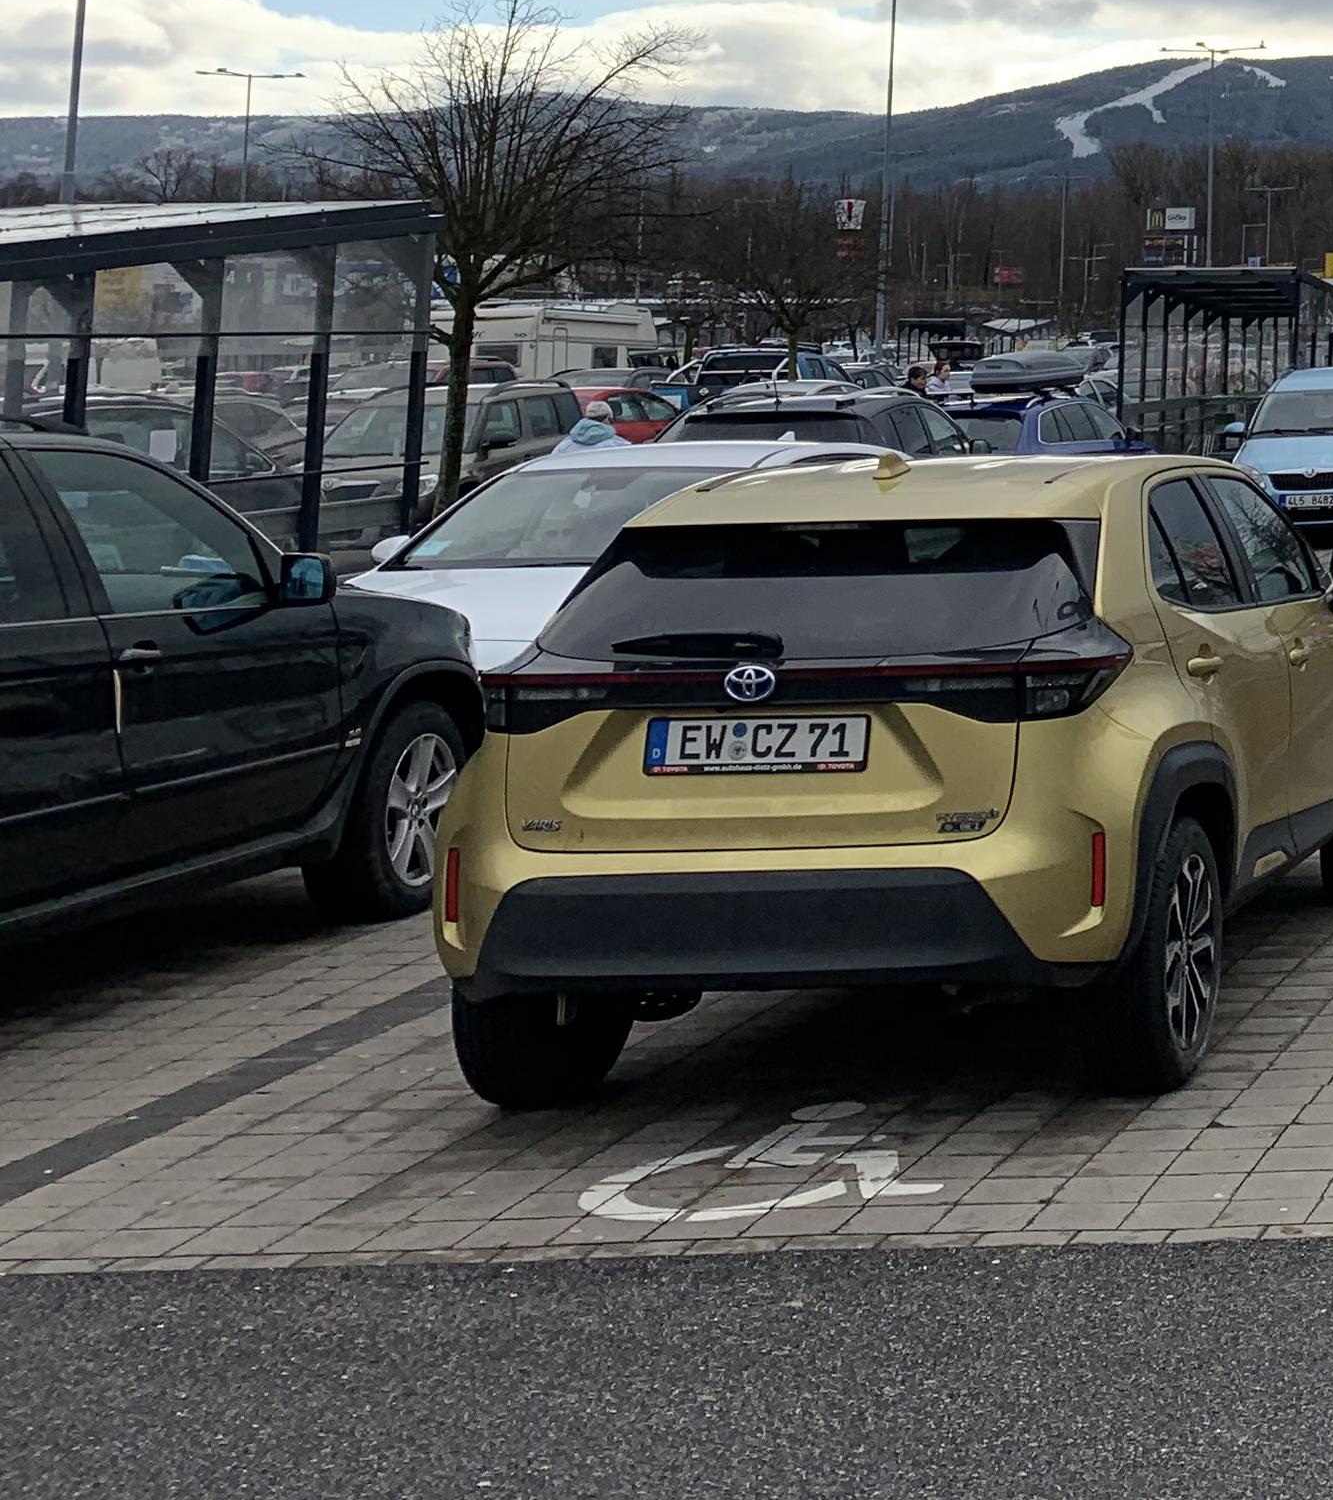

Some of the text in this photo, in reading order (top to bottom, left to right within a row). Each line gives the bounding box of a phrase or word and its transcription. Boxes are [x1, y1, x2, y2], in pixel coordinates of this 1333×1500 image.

[652, 748, 660, 758] D
[679, 723, 849, 760] EW CZ 71
